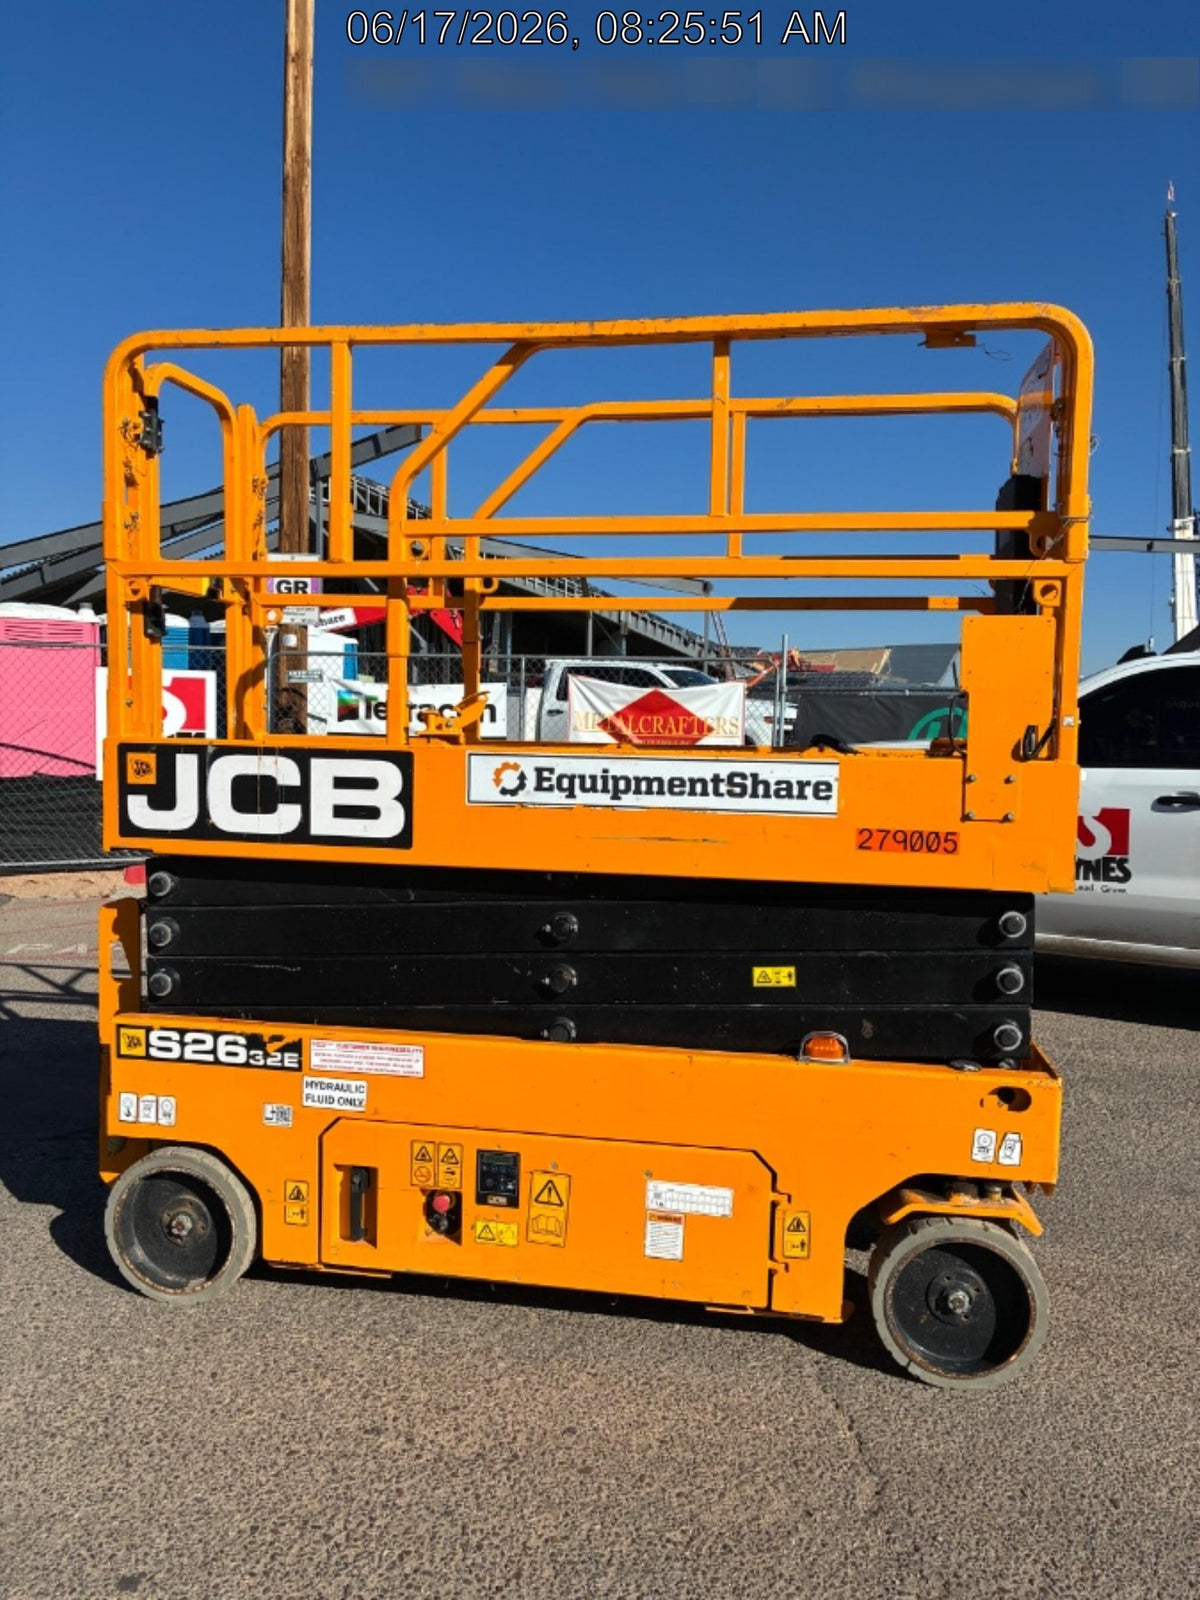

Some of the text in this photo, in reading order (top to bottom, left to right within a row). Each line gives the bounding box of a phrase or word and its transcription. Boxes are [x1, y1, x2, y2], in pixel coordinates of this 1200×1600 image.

[573, 711, 740, 736] METALCRAFTERS
[126, 752, 406, 839] JCB
[533, 766, 833, 800] EquipmentShare
[857, 827, 959, 855] 279005
[305, 1080, 365, 1094] HYDRAULIC
[305, 1093, 365, 1108] FLUID ONLY
